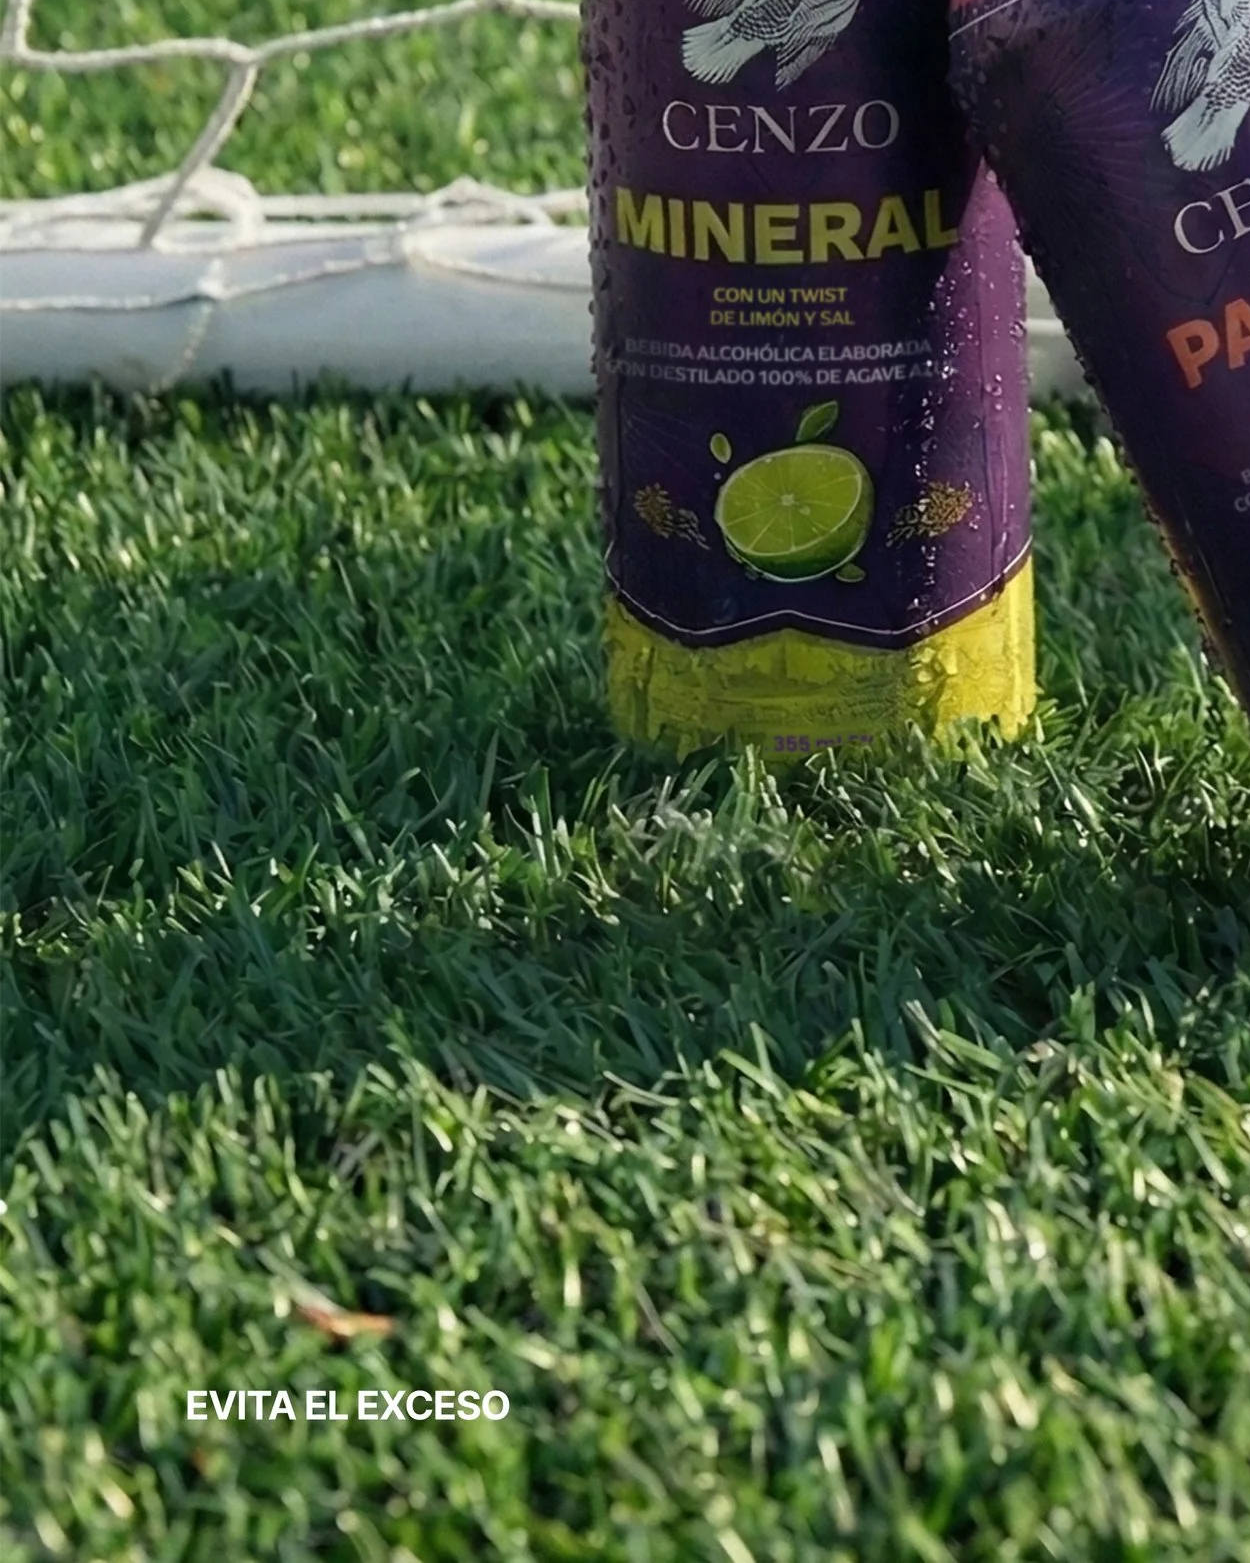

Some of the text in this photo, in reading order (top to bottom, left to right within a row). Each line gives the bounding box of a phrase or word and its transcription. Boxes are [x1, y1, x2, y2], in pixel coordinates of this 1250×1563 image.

[663, 100, 900, 154] CENZO
[615, 186, 960, 265] MINERAL
[712, 287, 848, 304] CON UN TWIST
[710, 307, 855, 327] DE LIMÓN Y SAL
[625, 338, 932, 362] BEBIDA ALCOHÓLICA ELABORADA
[650, 364, 755, 385] DESTILADO
[758, 369, 813, 386] 100%
[816, 369, 841, 385] DE
[845, 364, 906, 384] AGAVE
[773, 735, 810, 753] 355
